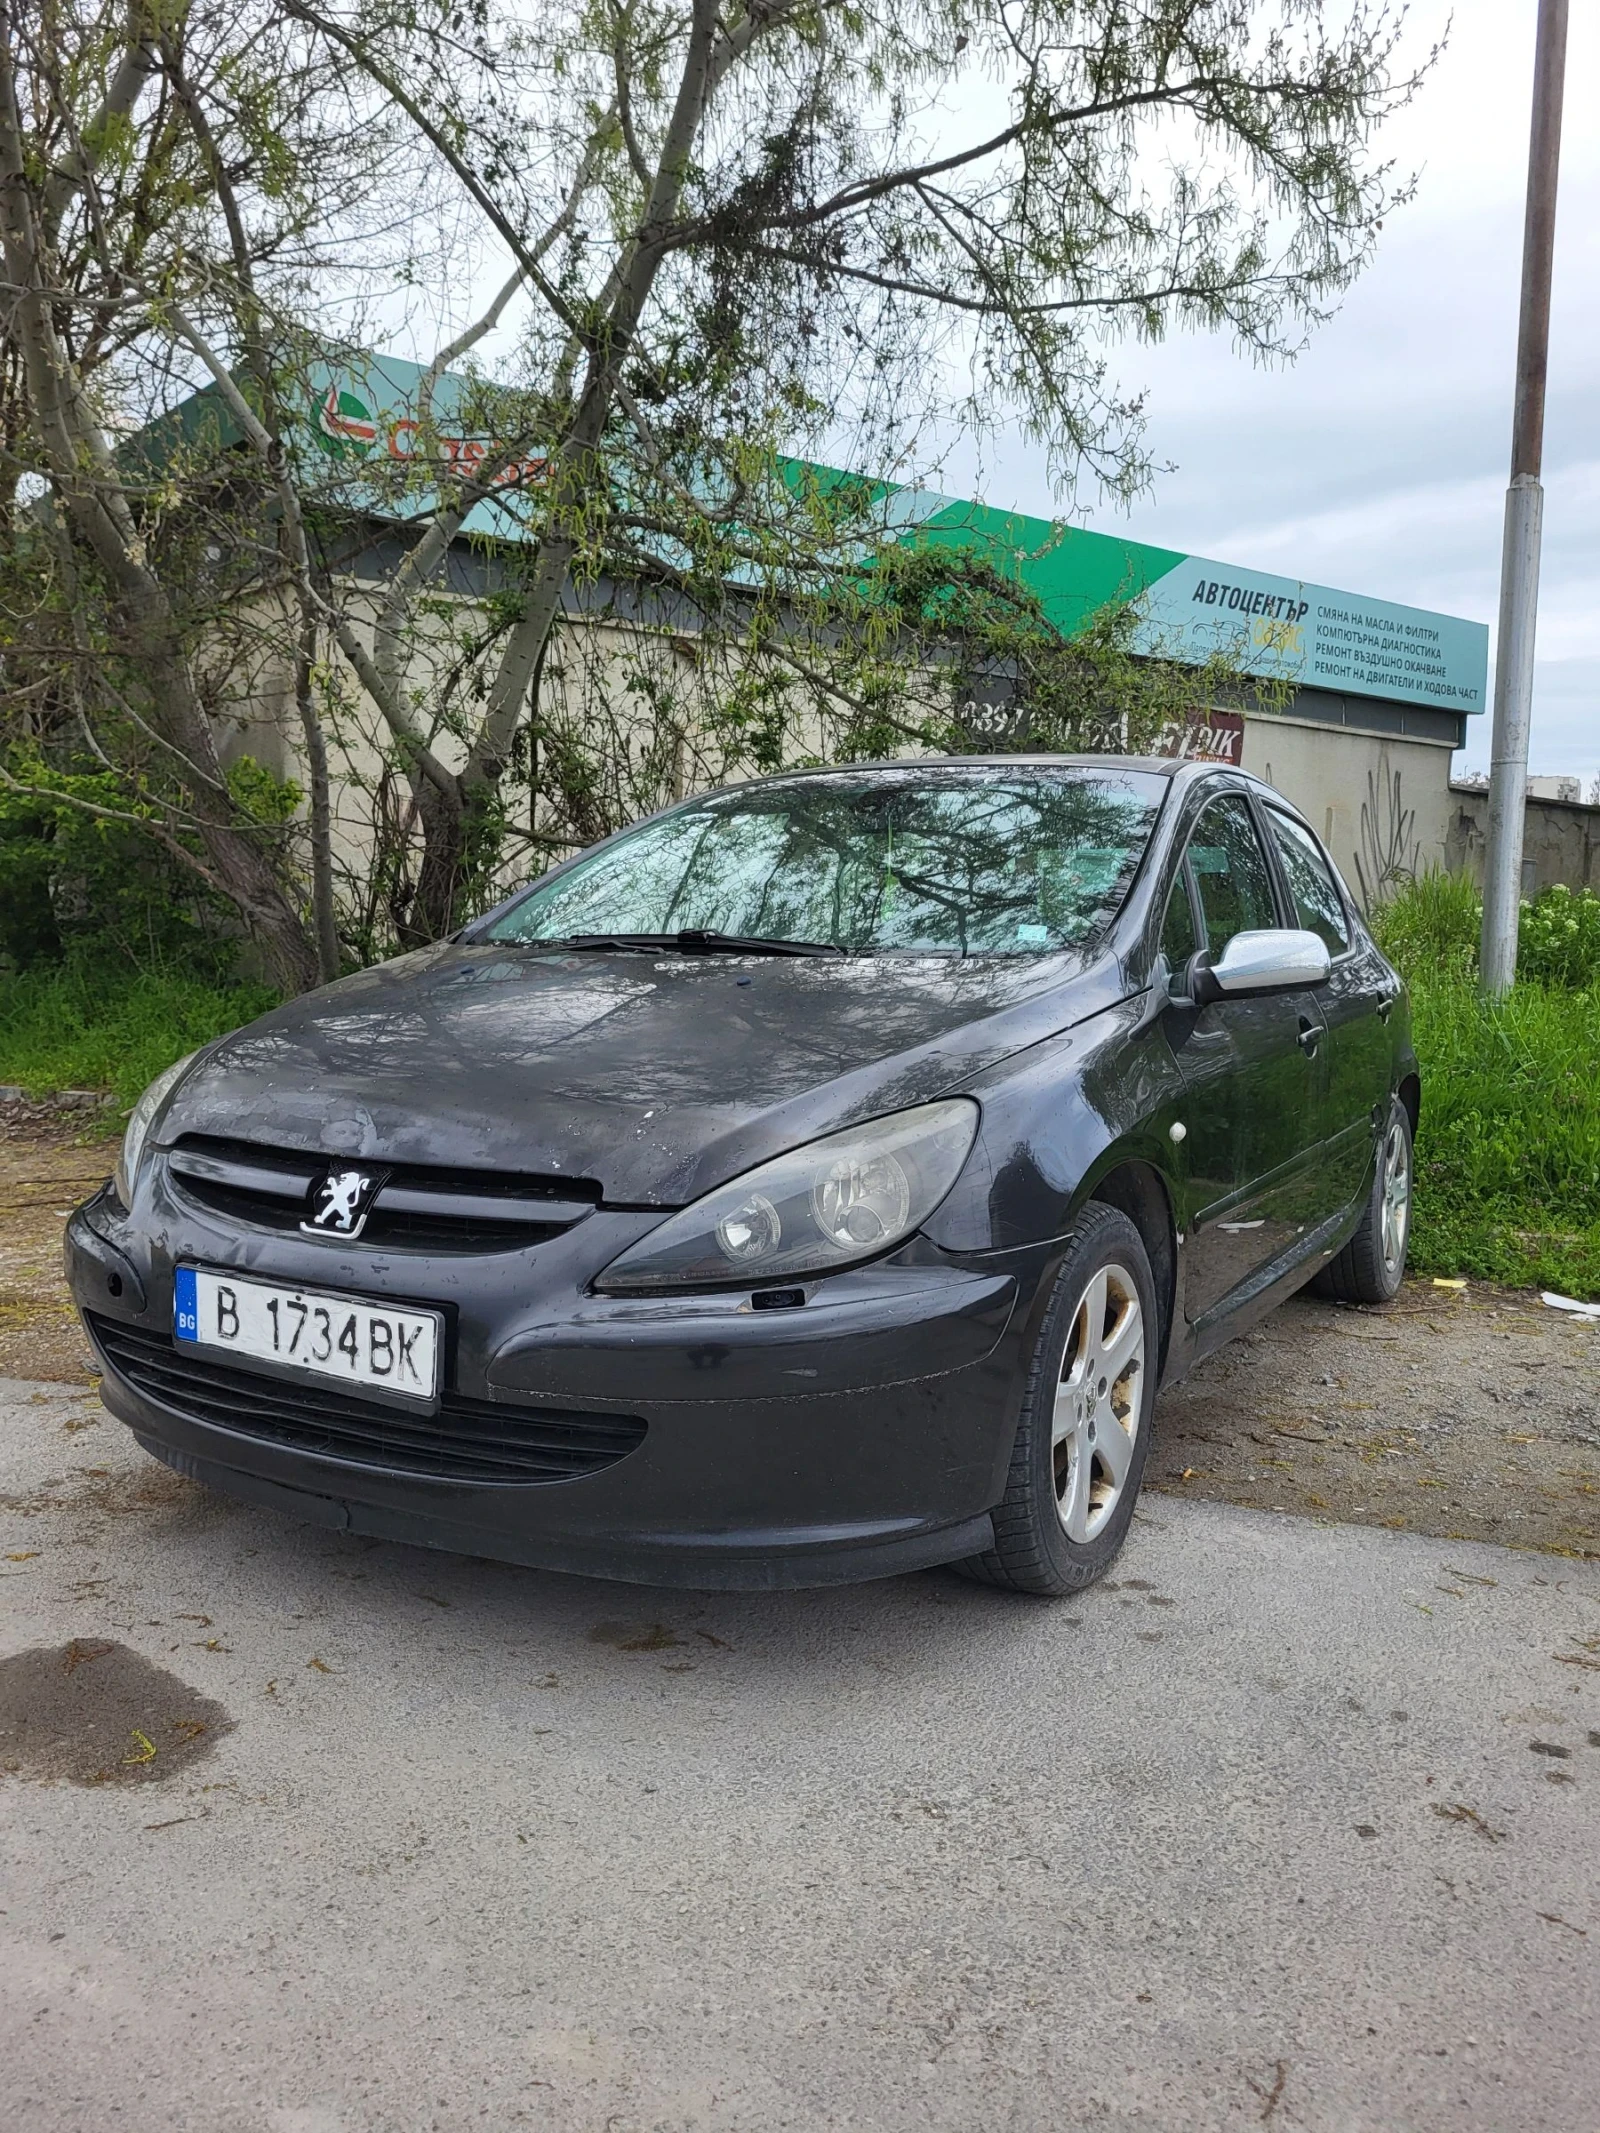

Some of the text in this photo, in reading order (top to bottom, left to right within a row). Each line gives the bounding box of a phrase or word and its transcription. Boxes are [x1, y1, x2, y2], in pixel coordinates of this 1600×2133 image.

[1191, 580, 1309, 622] АВТОЦЕНТЪР
[1316, 623, 1441, 659] КОМПЮТЪРНА ДИАГНОСТИКА
[1317, 606, 1439, 642] СМЯНА НА МАСЛА И ФИЛТРИ
[1315, 642, 1447, 678] РЕМОНТ ВЪЗДУШНО ОКАЧВАНЕ
[1315, 660, 1478, 701] РЕМОНТ НА ДВИГАТЕЛИ И ХОДОВА ЧАСТ
[179, 1312, 196, 1331] BG
